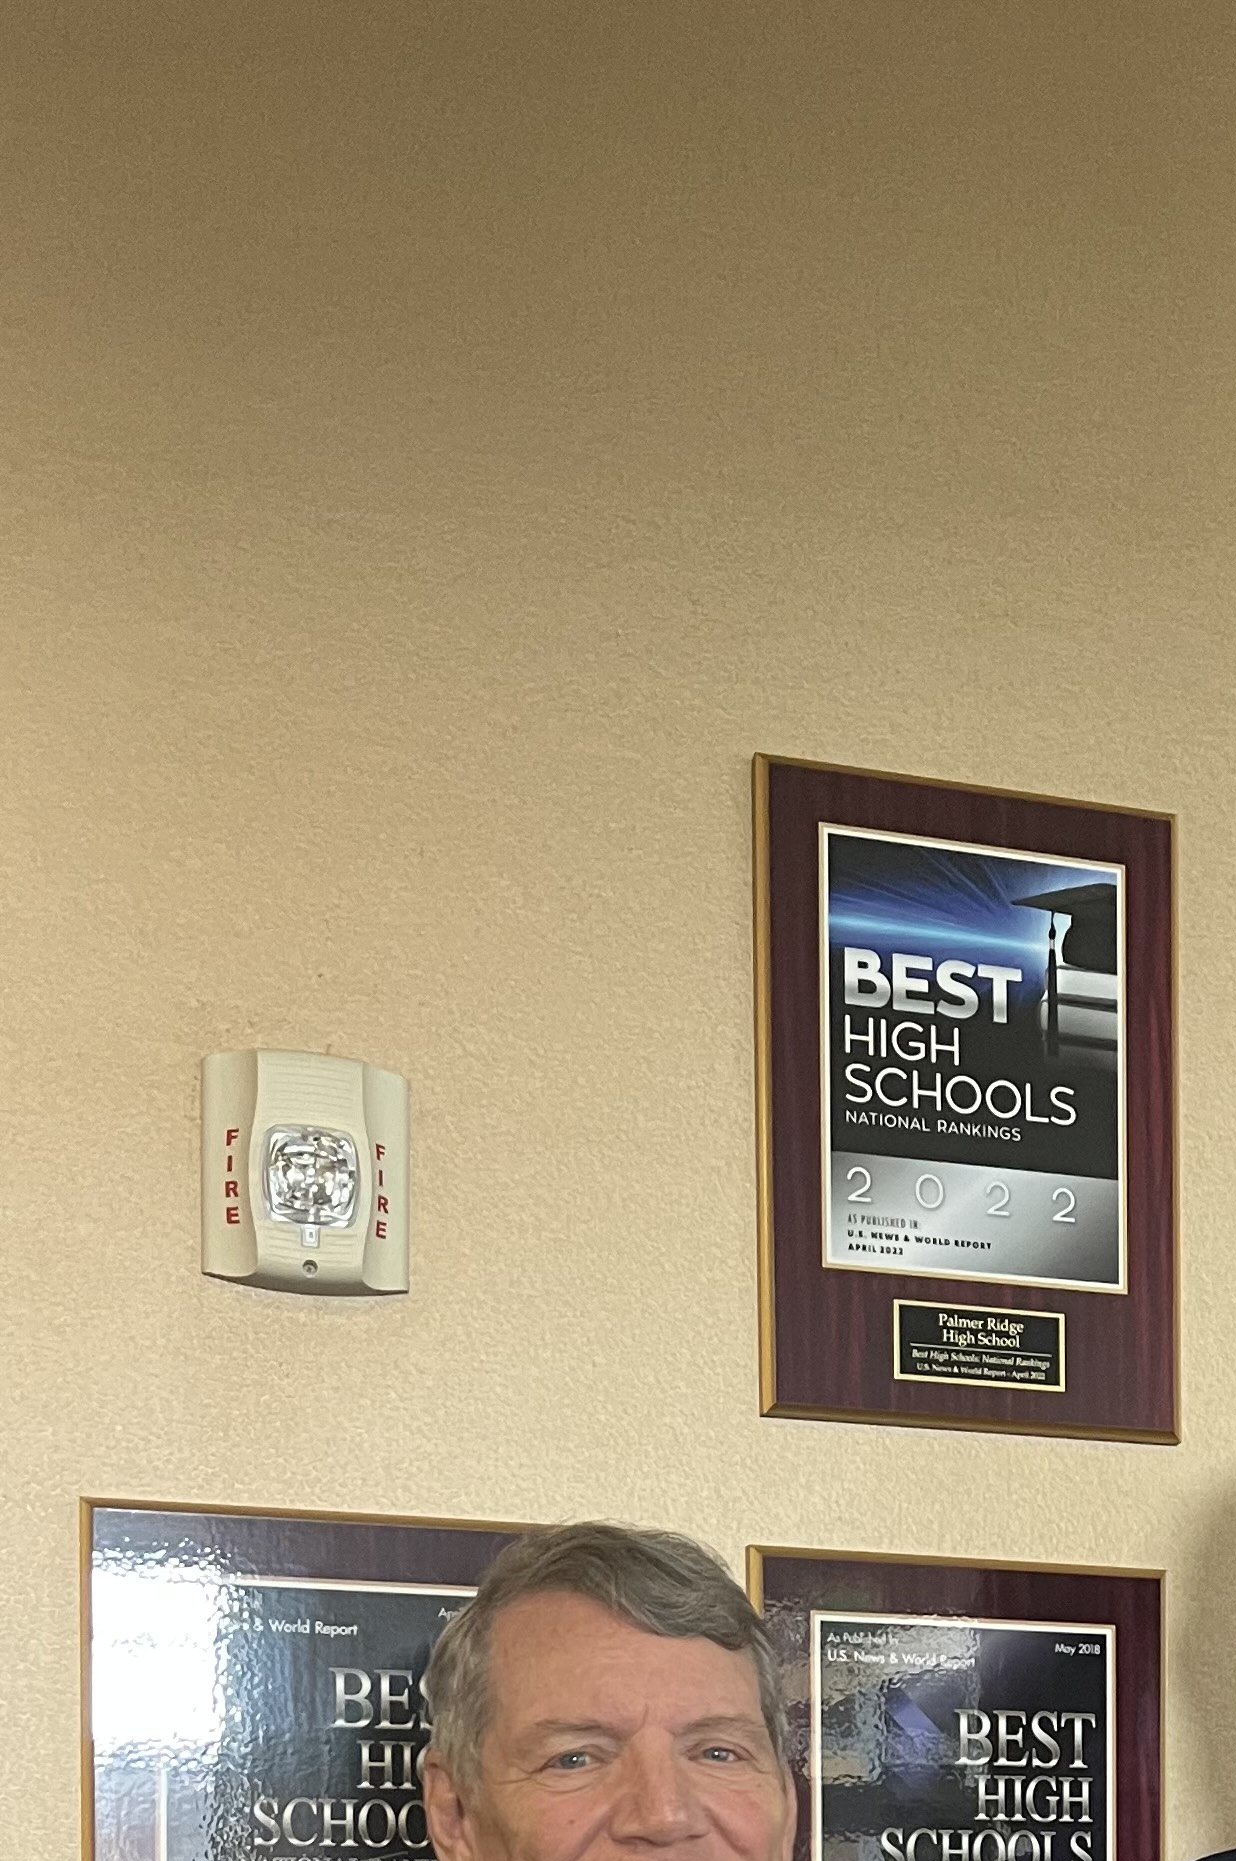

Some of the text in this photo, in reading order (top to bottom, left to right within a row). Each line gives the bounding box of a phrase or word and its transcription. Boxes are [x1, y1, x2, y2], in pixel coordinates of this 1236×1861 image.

[844, 947, 1022, 1023] BEST
[844, 1015, 960, 1066] HIGH
[844, 1063, 1077, 1126] SCHOOLS
[845, 1109, 1022, 1142] NATIONAL RANKINGS
[225, 1128, 240, 1224] FIRE
[375, 1143, 389, 1239] FIRE
[848, 1213, 857, 1224] AS
[860, 1214, 906, 1229] PUBLISHED
[848, 1243, 877, 1253] APRIL
[871, 1231, 899, 1242] NEWS
[903, 1234, 910, 1242] &
[914, 1235, 950, 1246] WORLD
[954, 1239, 992, 1250] REPORT
[938, 1313, 1025, 1336] Palmer Ridge
[942, 1329, 1020, 1349] High School
[912, 1348, 929, 1359] Best
[929, 1350, 949, 1362] High
[981, 1354, 1015, 1366] National
[268, 1618, 310, 1634] World
[315, 1621, 358, 1638] Report
[827, 1649, 849, 1662] U.S.
[853, 1650, 886, 1664] News
[889, 1652, 899, 1665] &
[902, 1652, 937, 1667] World
[1054, 1642, 1076, 1657] May
[1078, 1642, 1101, 1656] 2018
[953, 1707, 1096, 1769] BEST
[974, 1774, 1094, 1823] HIGH
[253, 1797, 431, 1848] SCHOO
